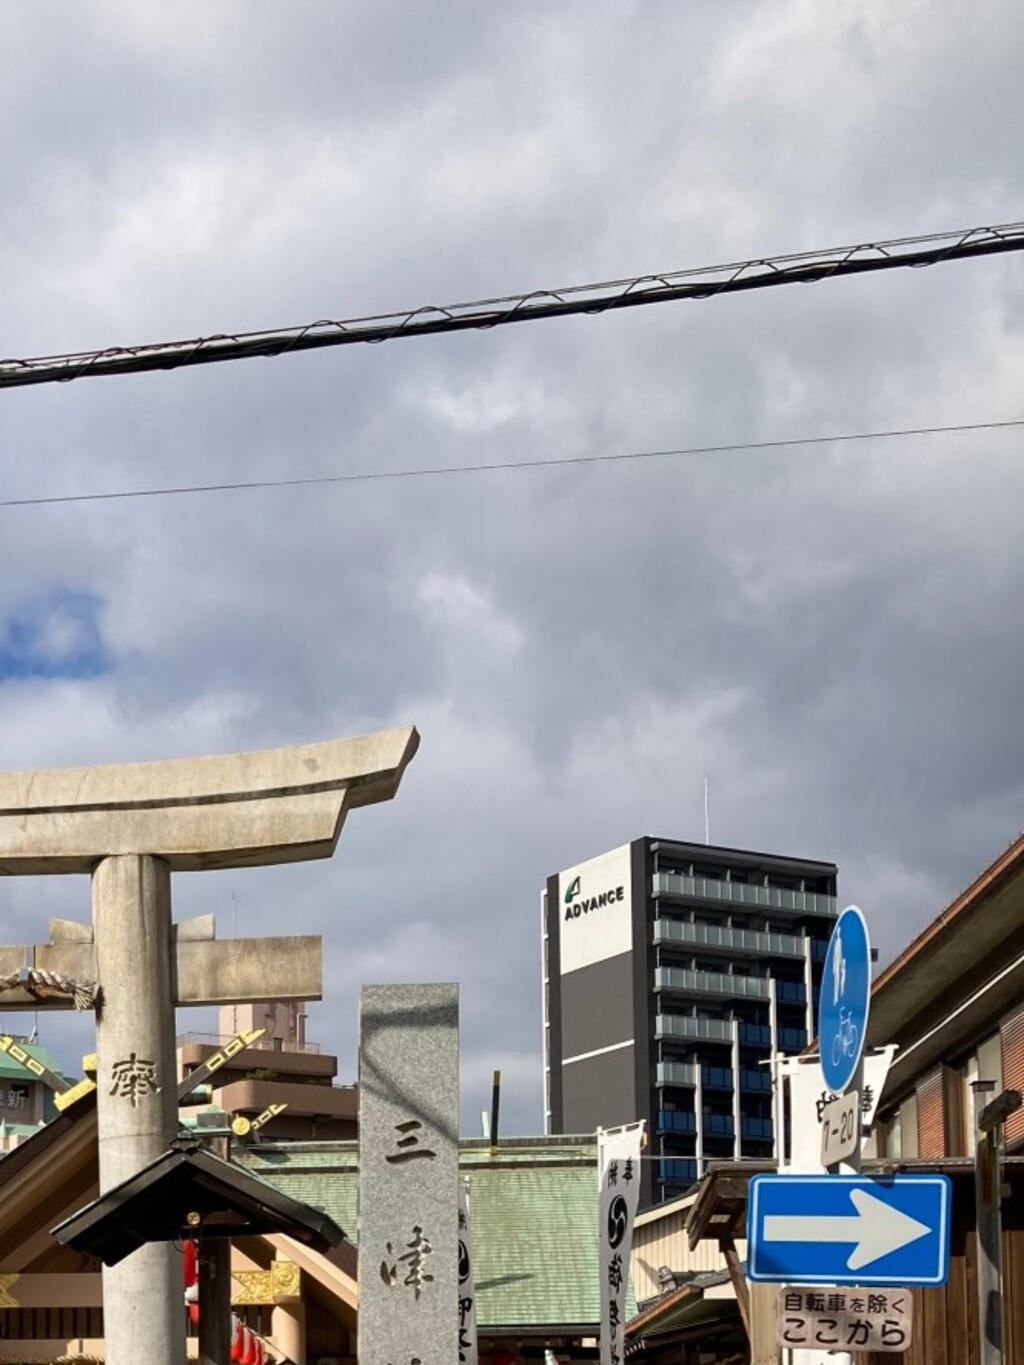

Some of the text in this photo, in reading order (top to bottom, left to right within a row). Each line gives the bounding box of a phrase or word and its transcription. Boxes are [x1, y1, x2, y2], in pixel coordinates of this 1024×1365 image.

[564, 886, 624, 921] ADVANCE
[784, 1292, 905, 1314] 自転車を除く
[783, 1318, 905, 1345] ここから
